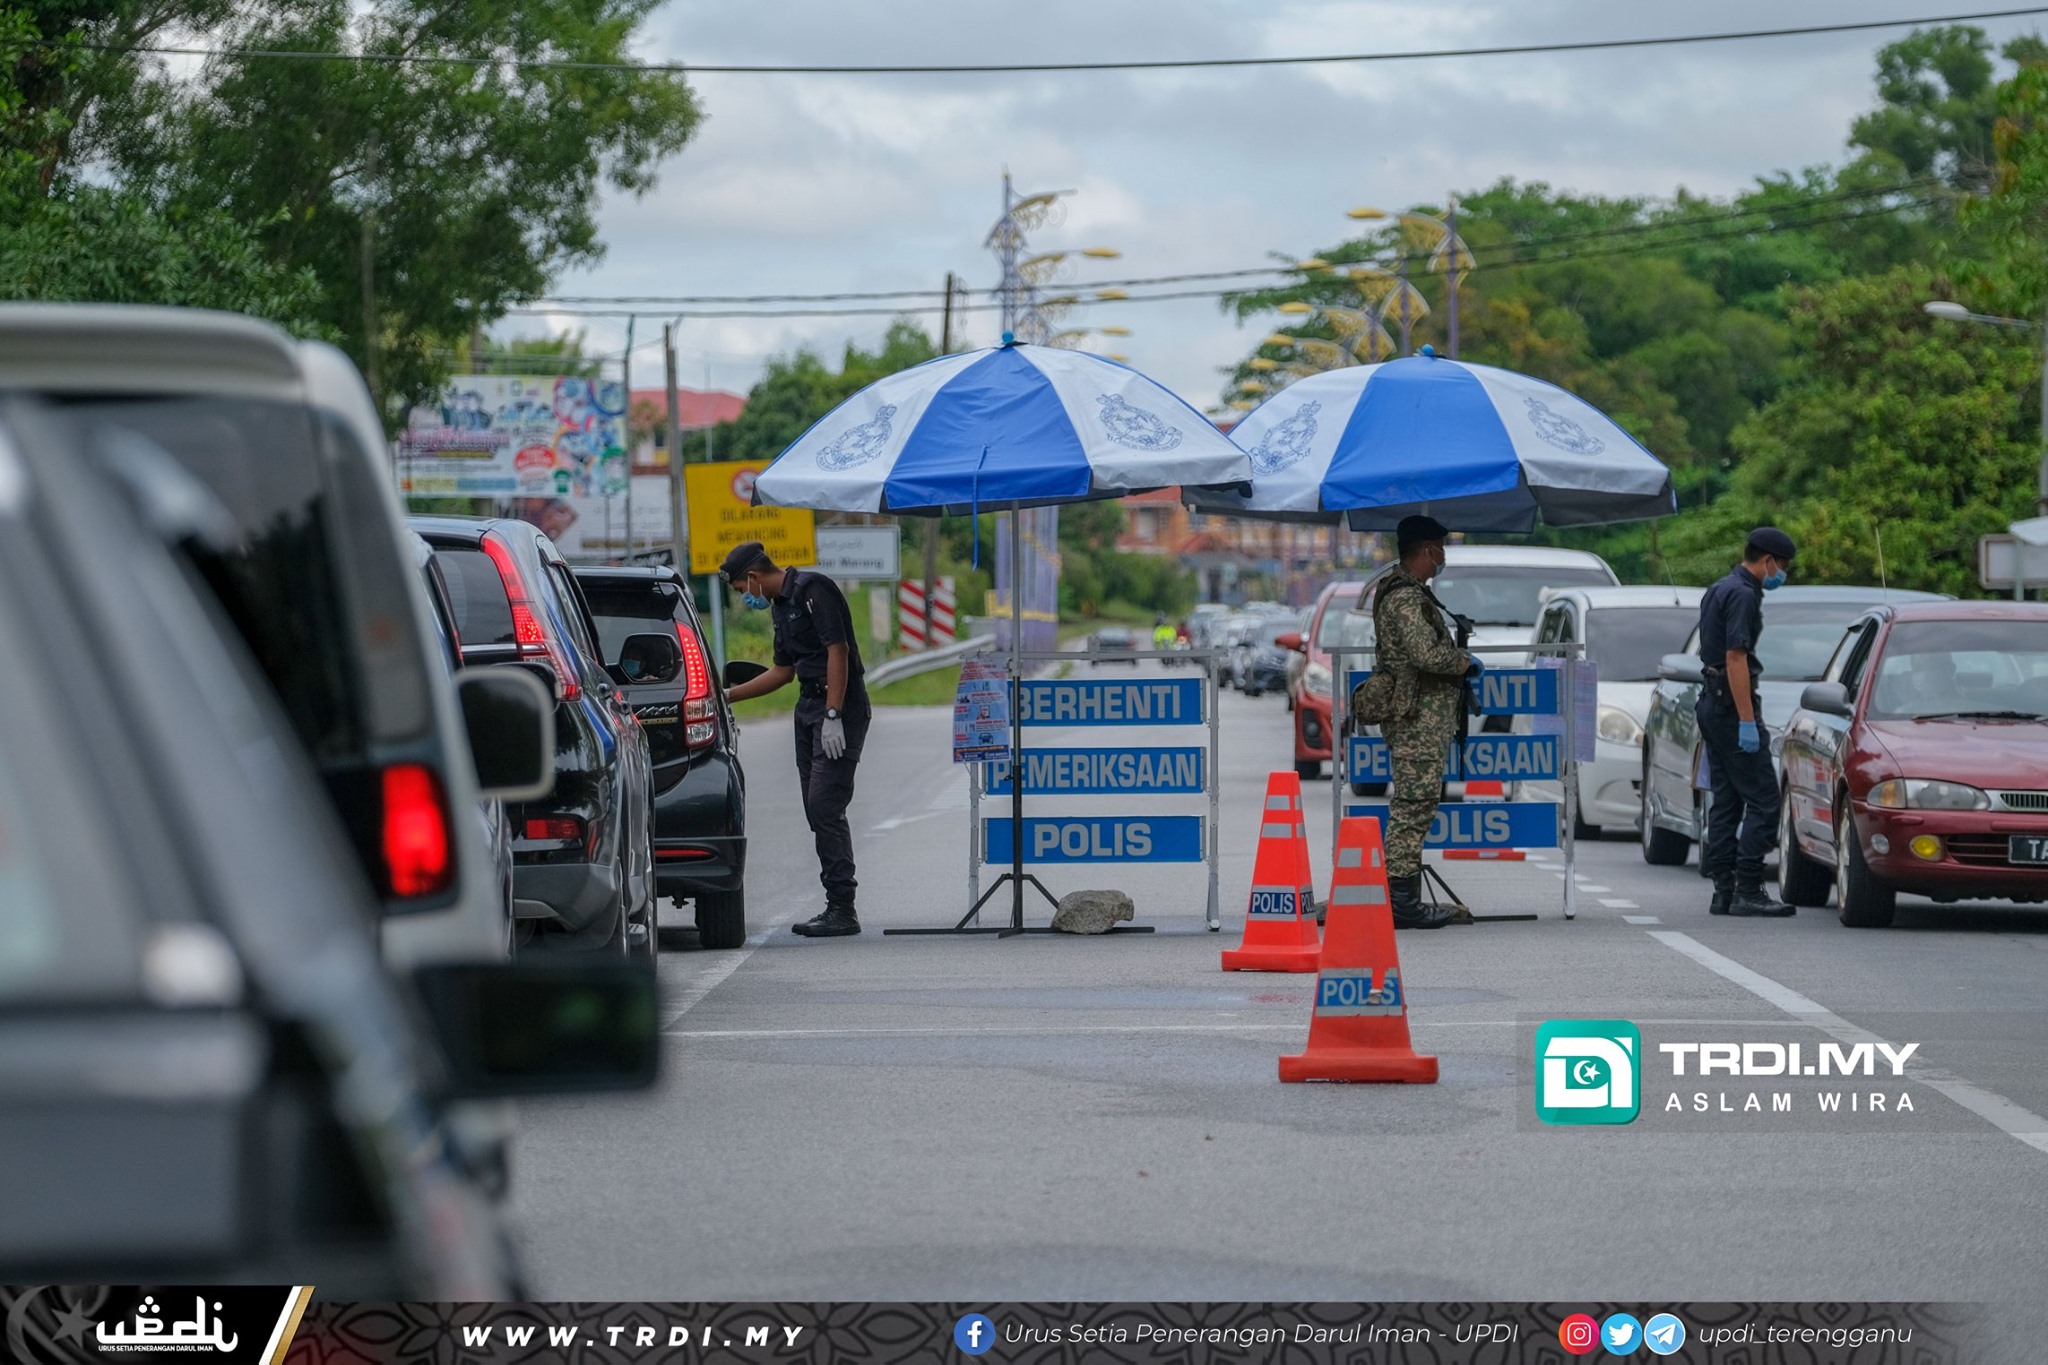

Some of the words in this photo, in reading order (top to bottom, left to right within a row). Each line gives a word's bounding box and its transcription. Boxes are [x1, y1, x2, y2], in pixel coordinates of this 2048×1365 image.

[1010, 685, 1181, 720] BERHENTI
[1354, 742, 1553, 776] PEIKSAAN
[1034, 823, 1153, 857] POLIS
[1424, 810, 1511, 843] OLIS
[1252, 892, 1295, 914] POLIS
